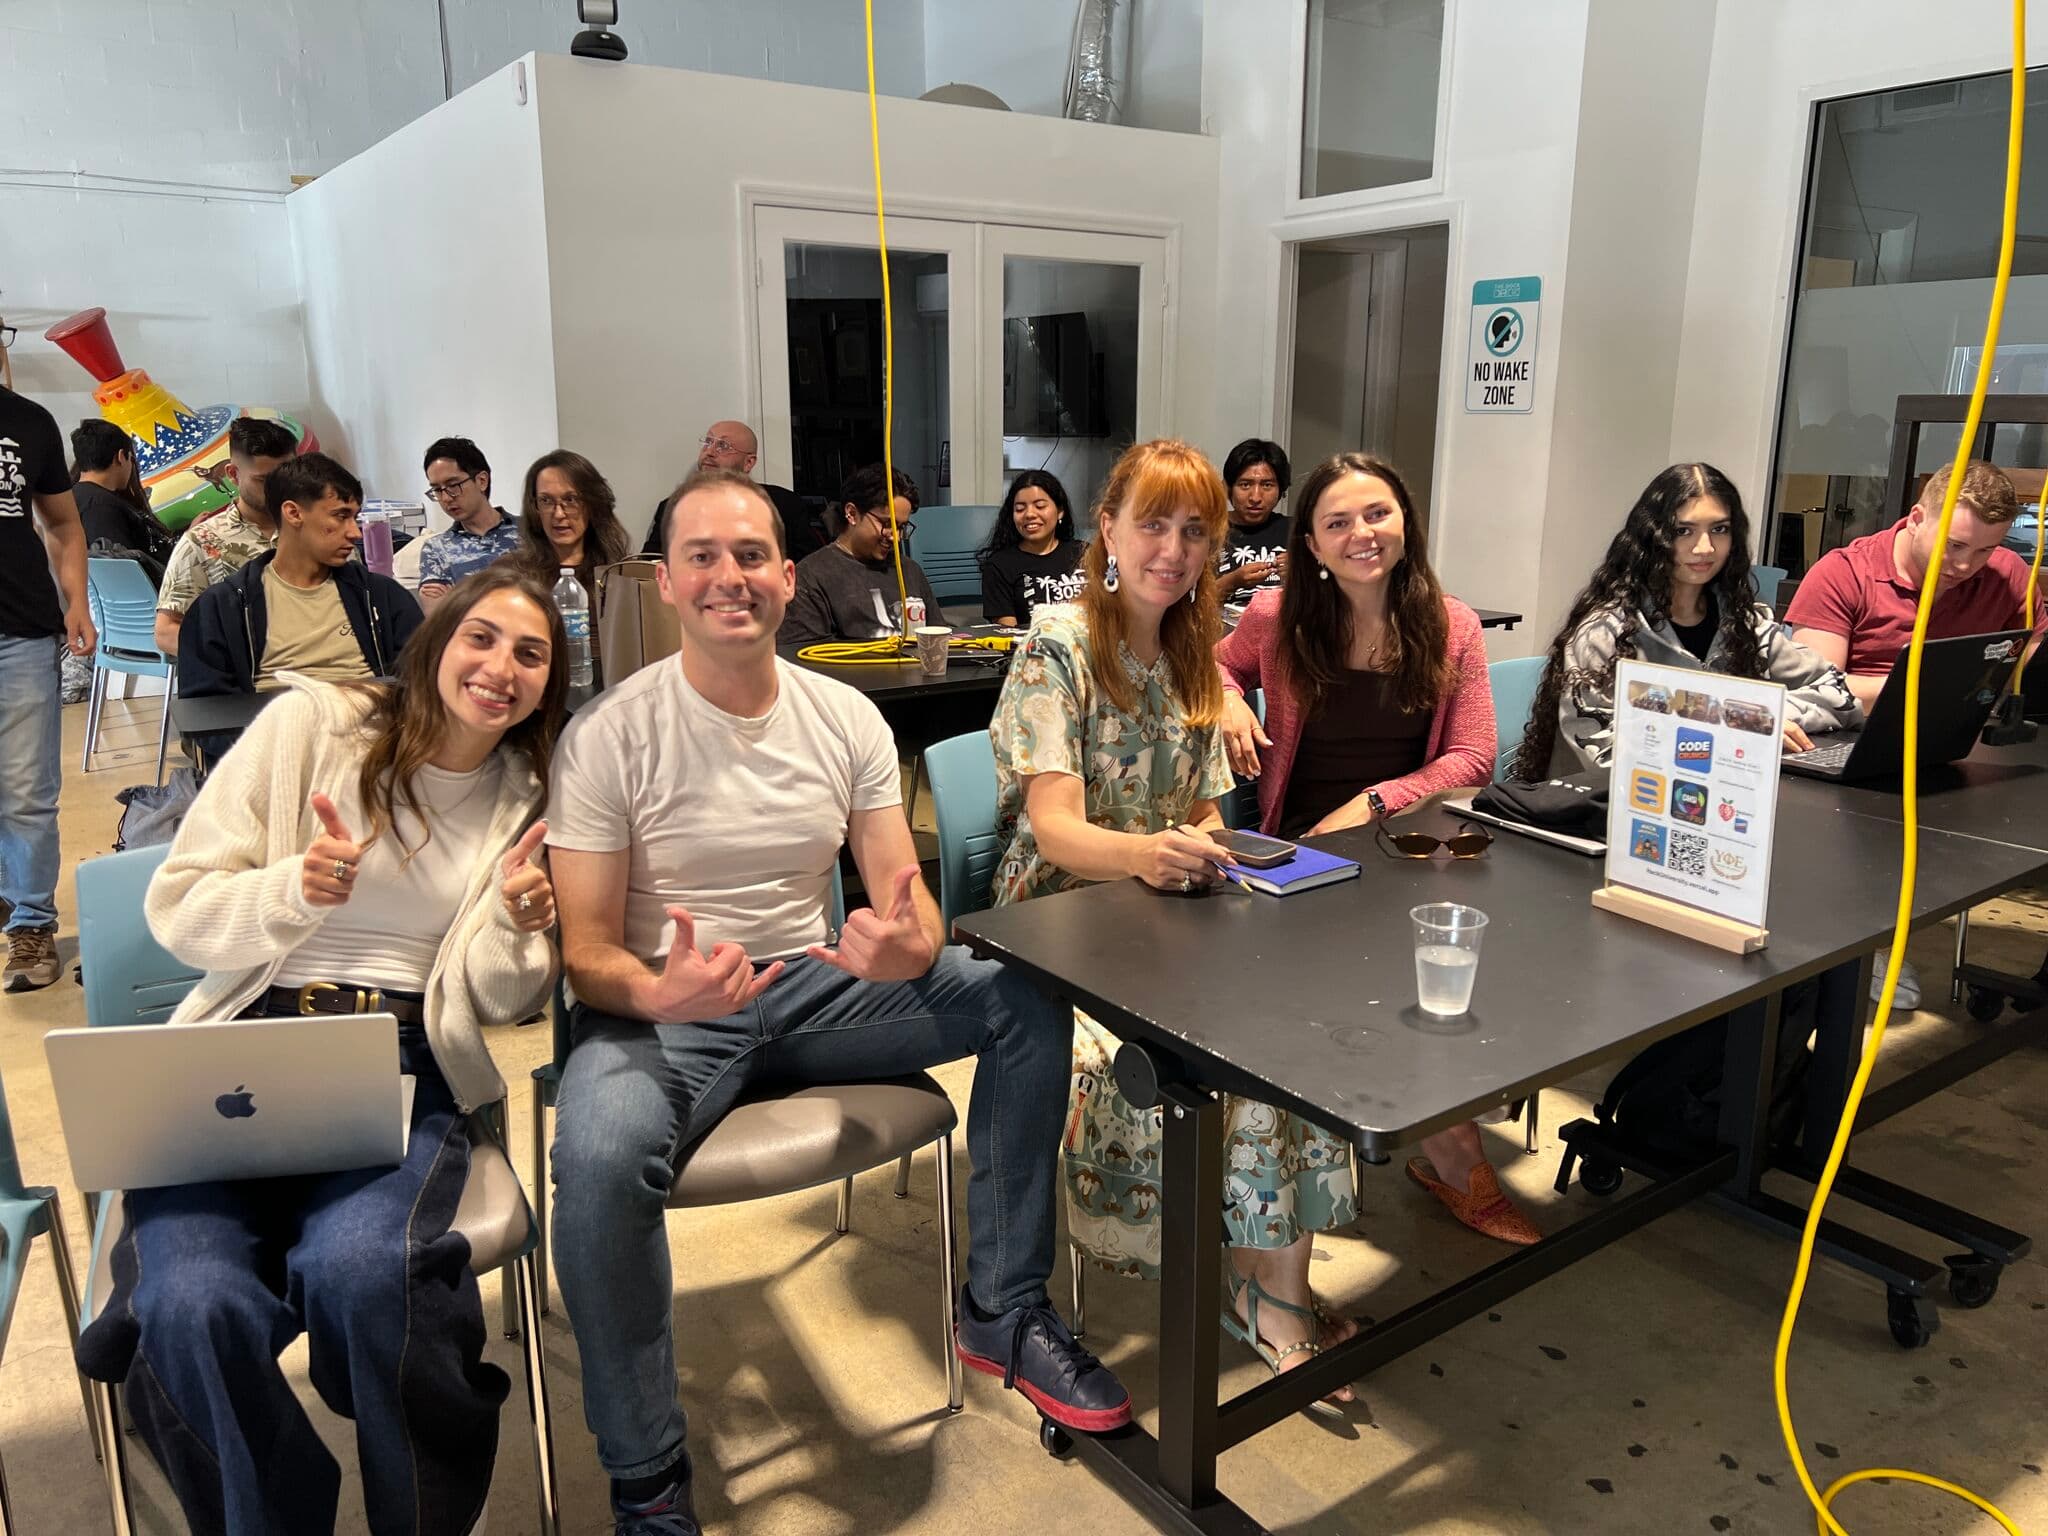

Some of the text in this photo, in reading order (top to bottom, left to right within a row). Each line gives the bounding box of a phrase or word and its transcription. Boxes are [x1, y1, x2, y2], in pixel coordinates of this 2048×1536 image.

[1474, 361, 1529, 381] NO WAKE
[1483, 386, 1515, 405] ZONE
[1678, 741, 1710, 752] CODE
